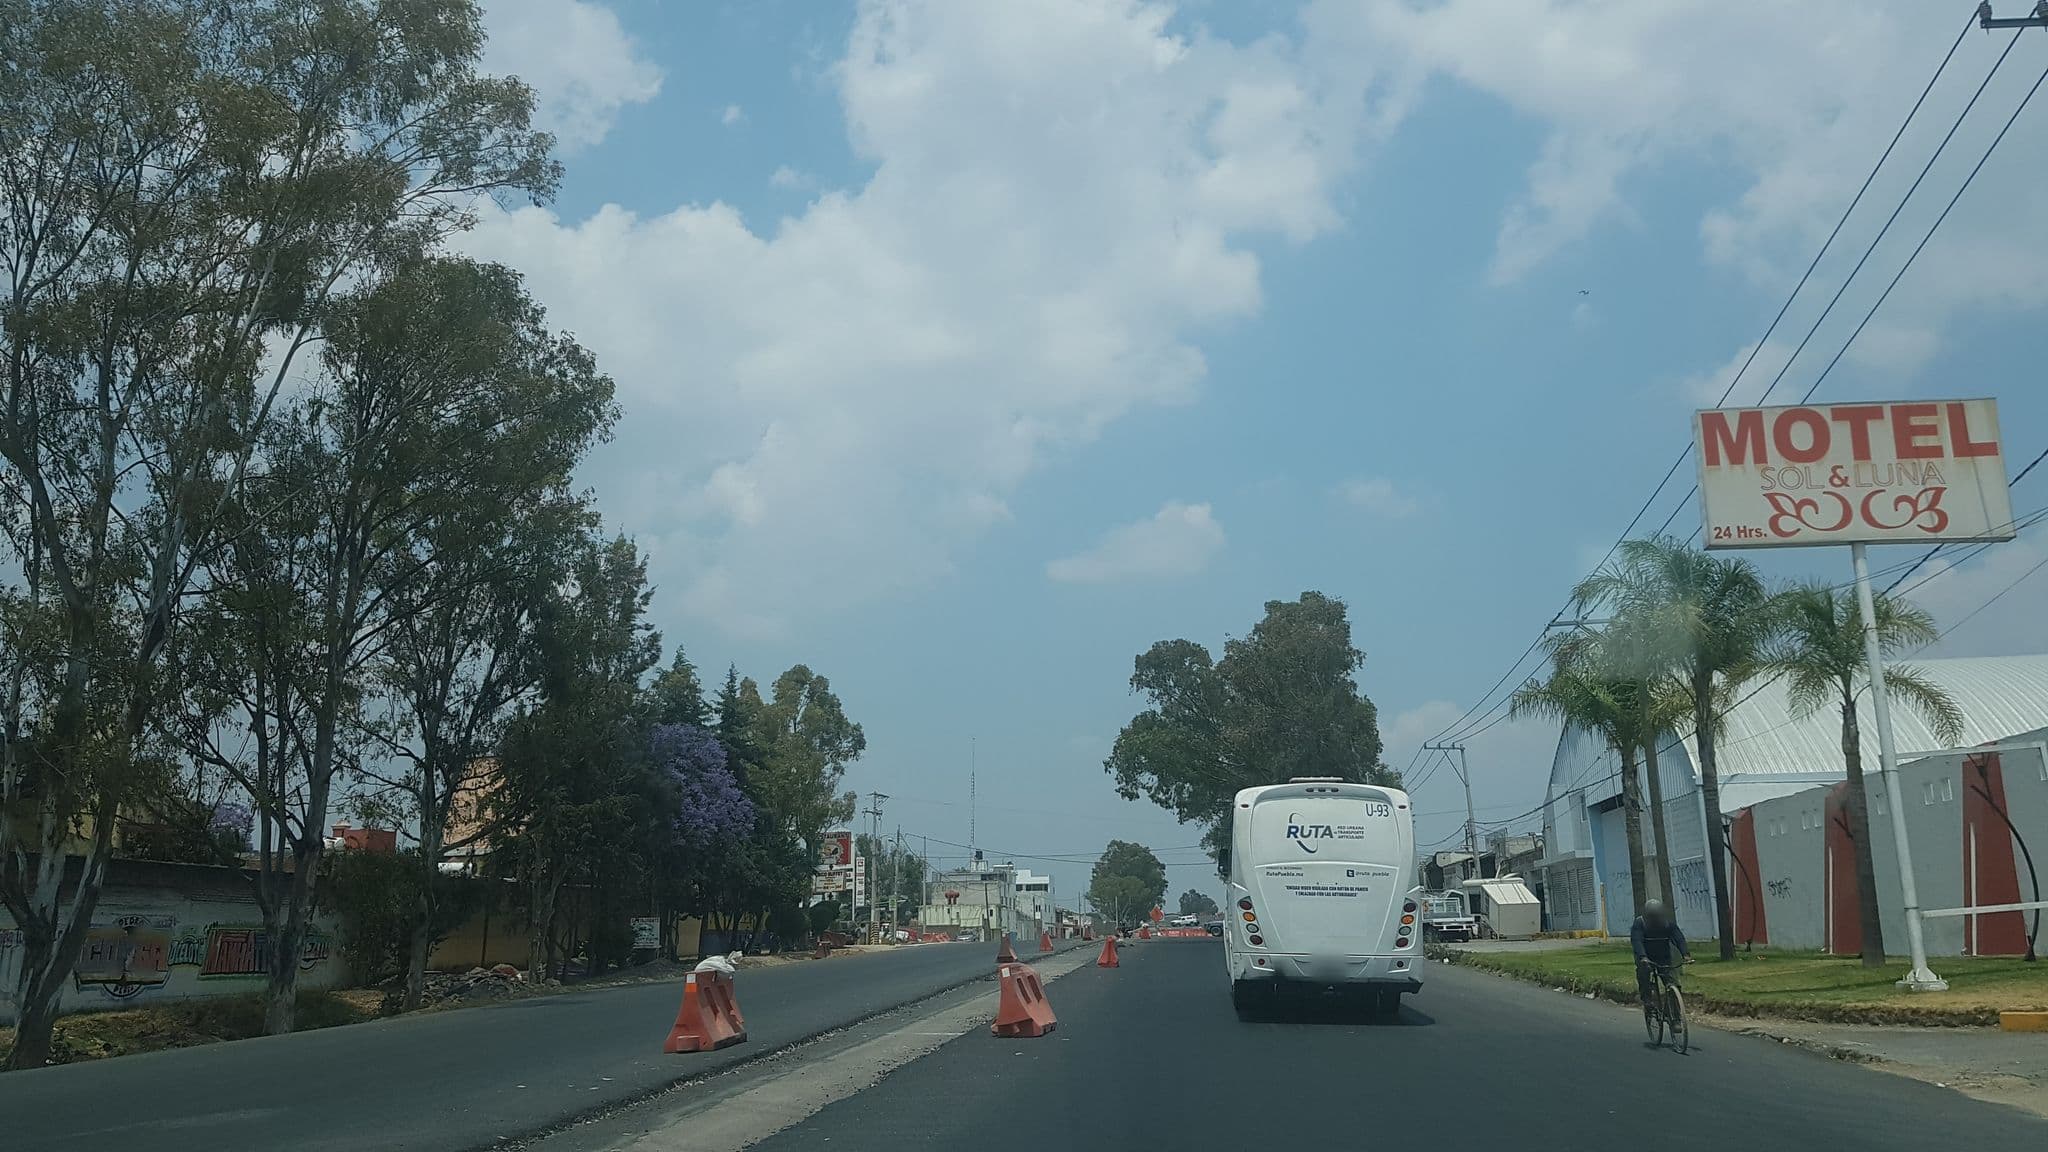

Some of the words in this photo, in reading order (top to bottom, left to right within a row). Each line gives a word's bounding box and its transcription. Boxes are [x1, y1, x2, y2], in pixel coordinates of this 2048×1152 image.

[1701, 403, 1999, 467] MOTEL
[1713, 526, 1733, 540] 24
[1736, 525, 1768, 539] Hrs.
[1365, 803, 1390, 818] U-93
[1286, 824, 1334, 839] RUTA
